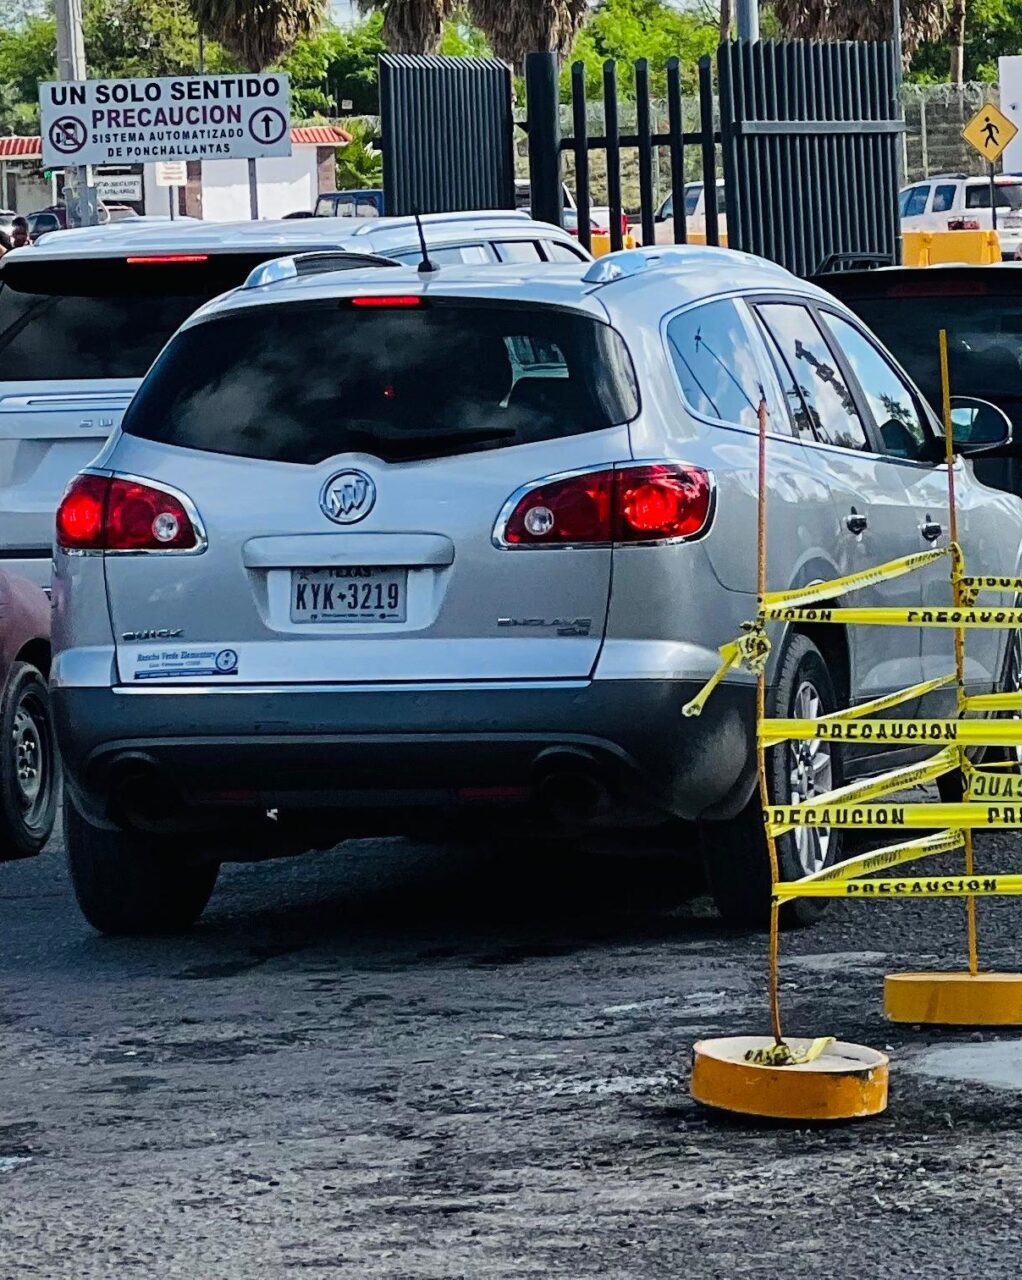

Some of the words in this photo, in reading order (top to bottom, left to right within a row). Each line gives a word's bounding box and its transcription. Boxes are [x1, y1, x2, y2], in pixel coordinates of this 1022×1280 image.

[50, 85, 86, 106] UN
[95, 82, 161, 104] SOLO
[170, 78, 280, 101] SENTIDO
[91, 104, 242, 129] PRECAUCION
[91, 132, 146, 144] SISTEMA
[149, 128, 244, 142] AUTOMATIZADO
[107, 147, 123, 158] DE
[126, 143, 231, 157] PONCHALLANTAS
[296, 583, 335, 610] KYK
[347, 583, 399, 609] 3219
